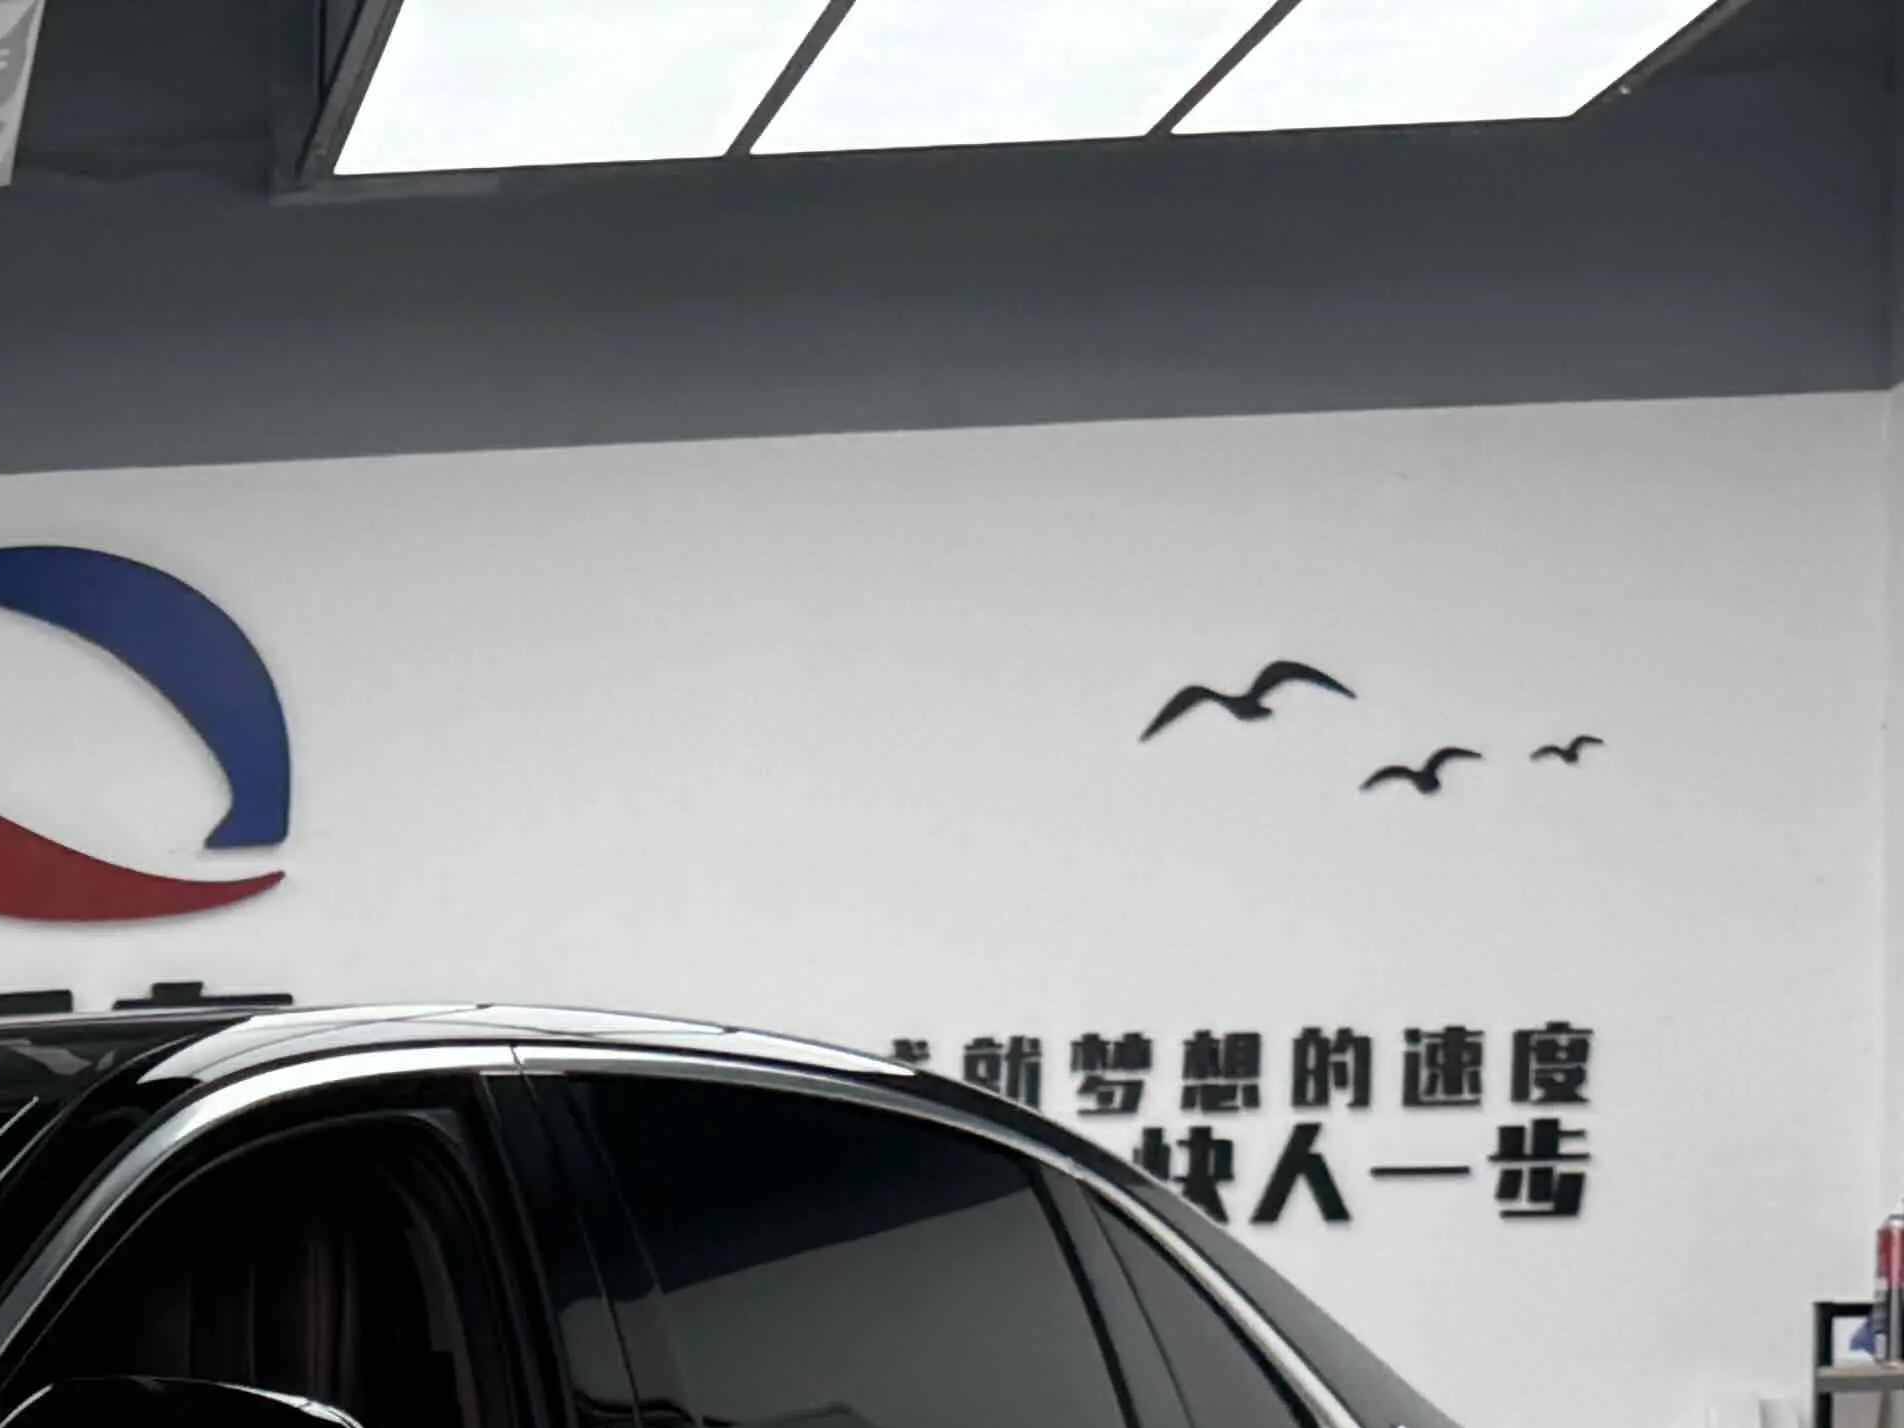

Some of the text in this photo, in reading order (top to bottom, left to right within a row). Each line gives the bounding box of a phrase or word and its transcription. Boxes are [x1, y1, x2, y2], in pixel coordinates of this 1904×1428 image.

[892, 1022, 1594, 1116] 就梦想的速度
[1134, 1118, 1591, 1223] 快人一步
